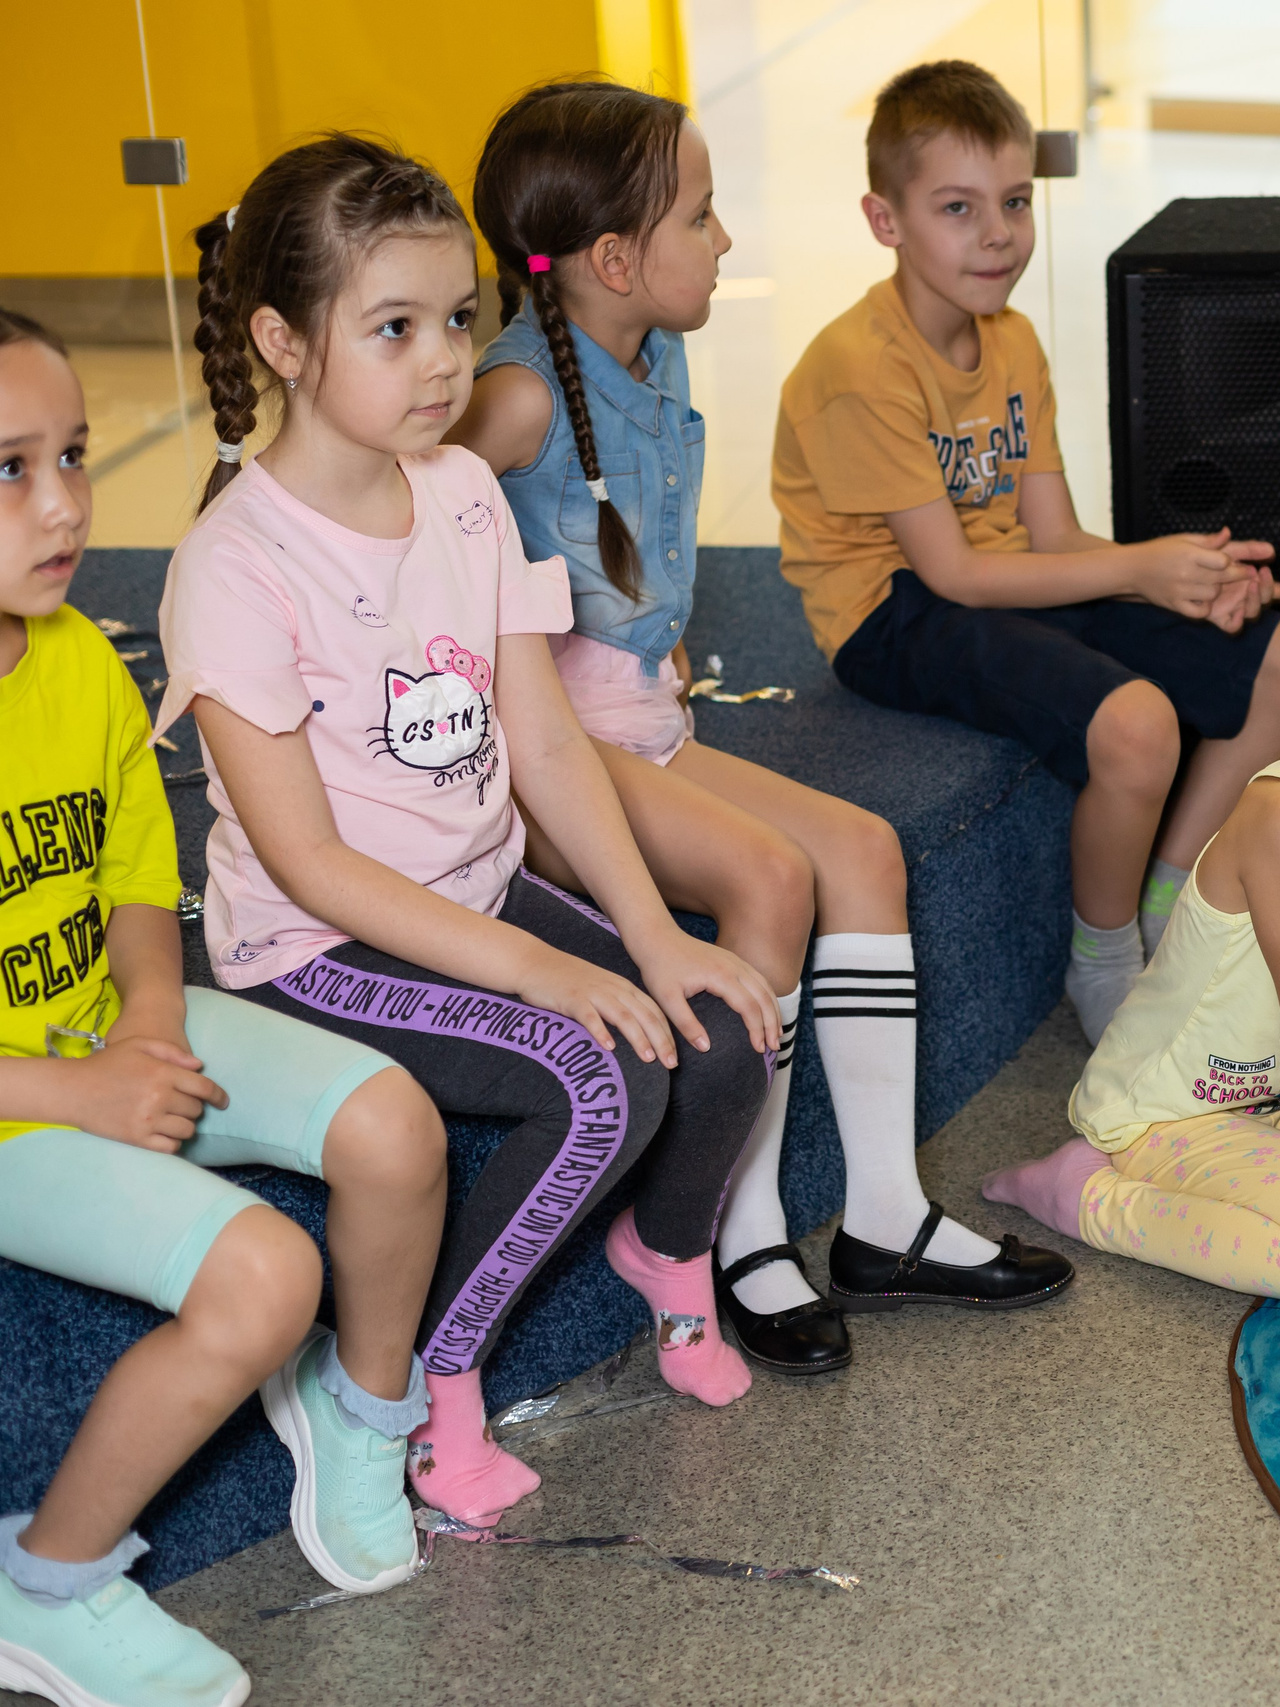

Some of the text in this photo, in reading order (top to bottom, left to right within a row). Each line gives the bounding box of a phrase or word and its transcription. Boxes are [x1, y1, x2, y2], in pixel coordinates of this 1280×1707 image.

[1, 894, 104, 1007] CLUB
[342, 978, 385, 1015] ON
[376, 984, 429, 1022] YOU
[430, 993, 565, 1052] HAPPINESS
[544, 1029, 618, 1104] LOOKS
[1209, 1068, 1269, 1086] BACK TO
[1213, 1058, 1271, 1072] FROM NOTHING
[1192, 1078, 1276, 1104] SCHOOL
[536, 1105, 620, 1212] FANTASTIC
[517, 1208, 565, 1236] ON
[496, 1232, 549, 1266] YOU
[440, 1270, 515, 1352] HAPPINESS
